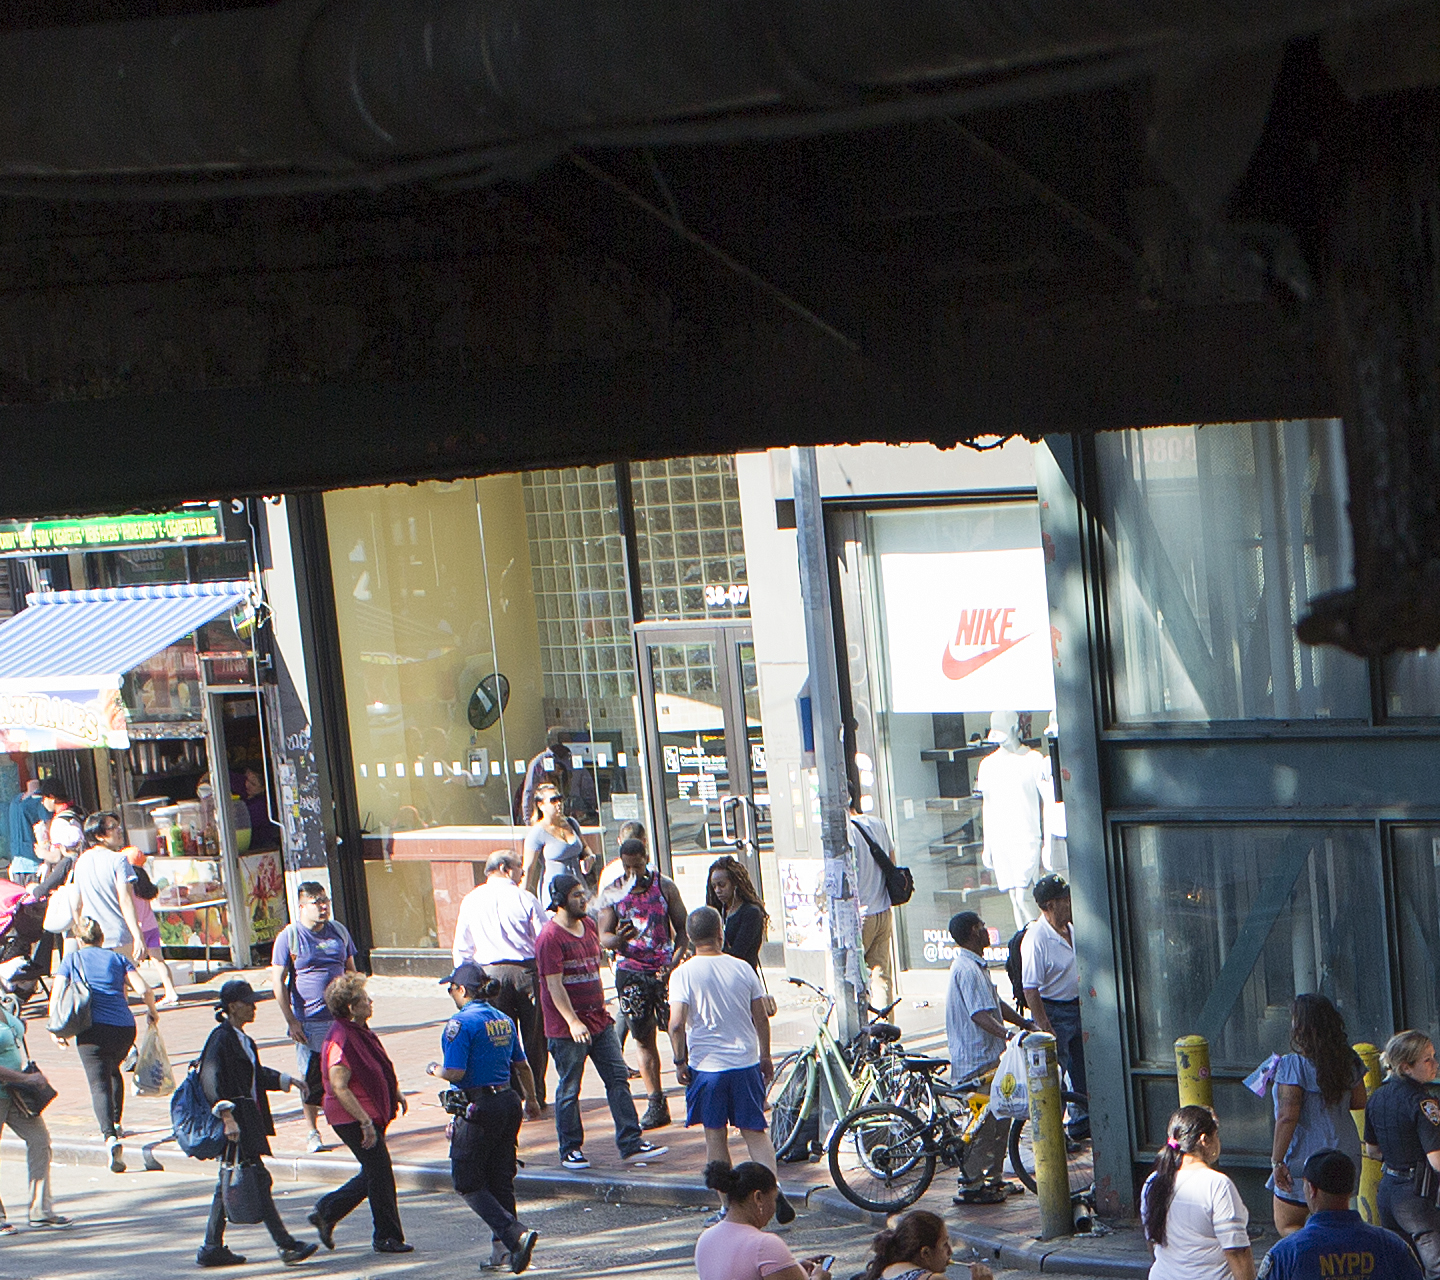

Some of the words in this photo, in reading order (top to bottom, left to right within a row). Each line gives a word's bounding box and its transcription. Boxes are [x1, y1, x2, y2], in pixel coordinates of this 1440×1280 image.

[705, 584, 749, 606] 38-07
[954, 607, 1017, 646] NIKE
[1318, 1251, 1375, 1277] NYPD
